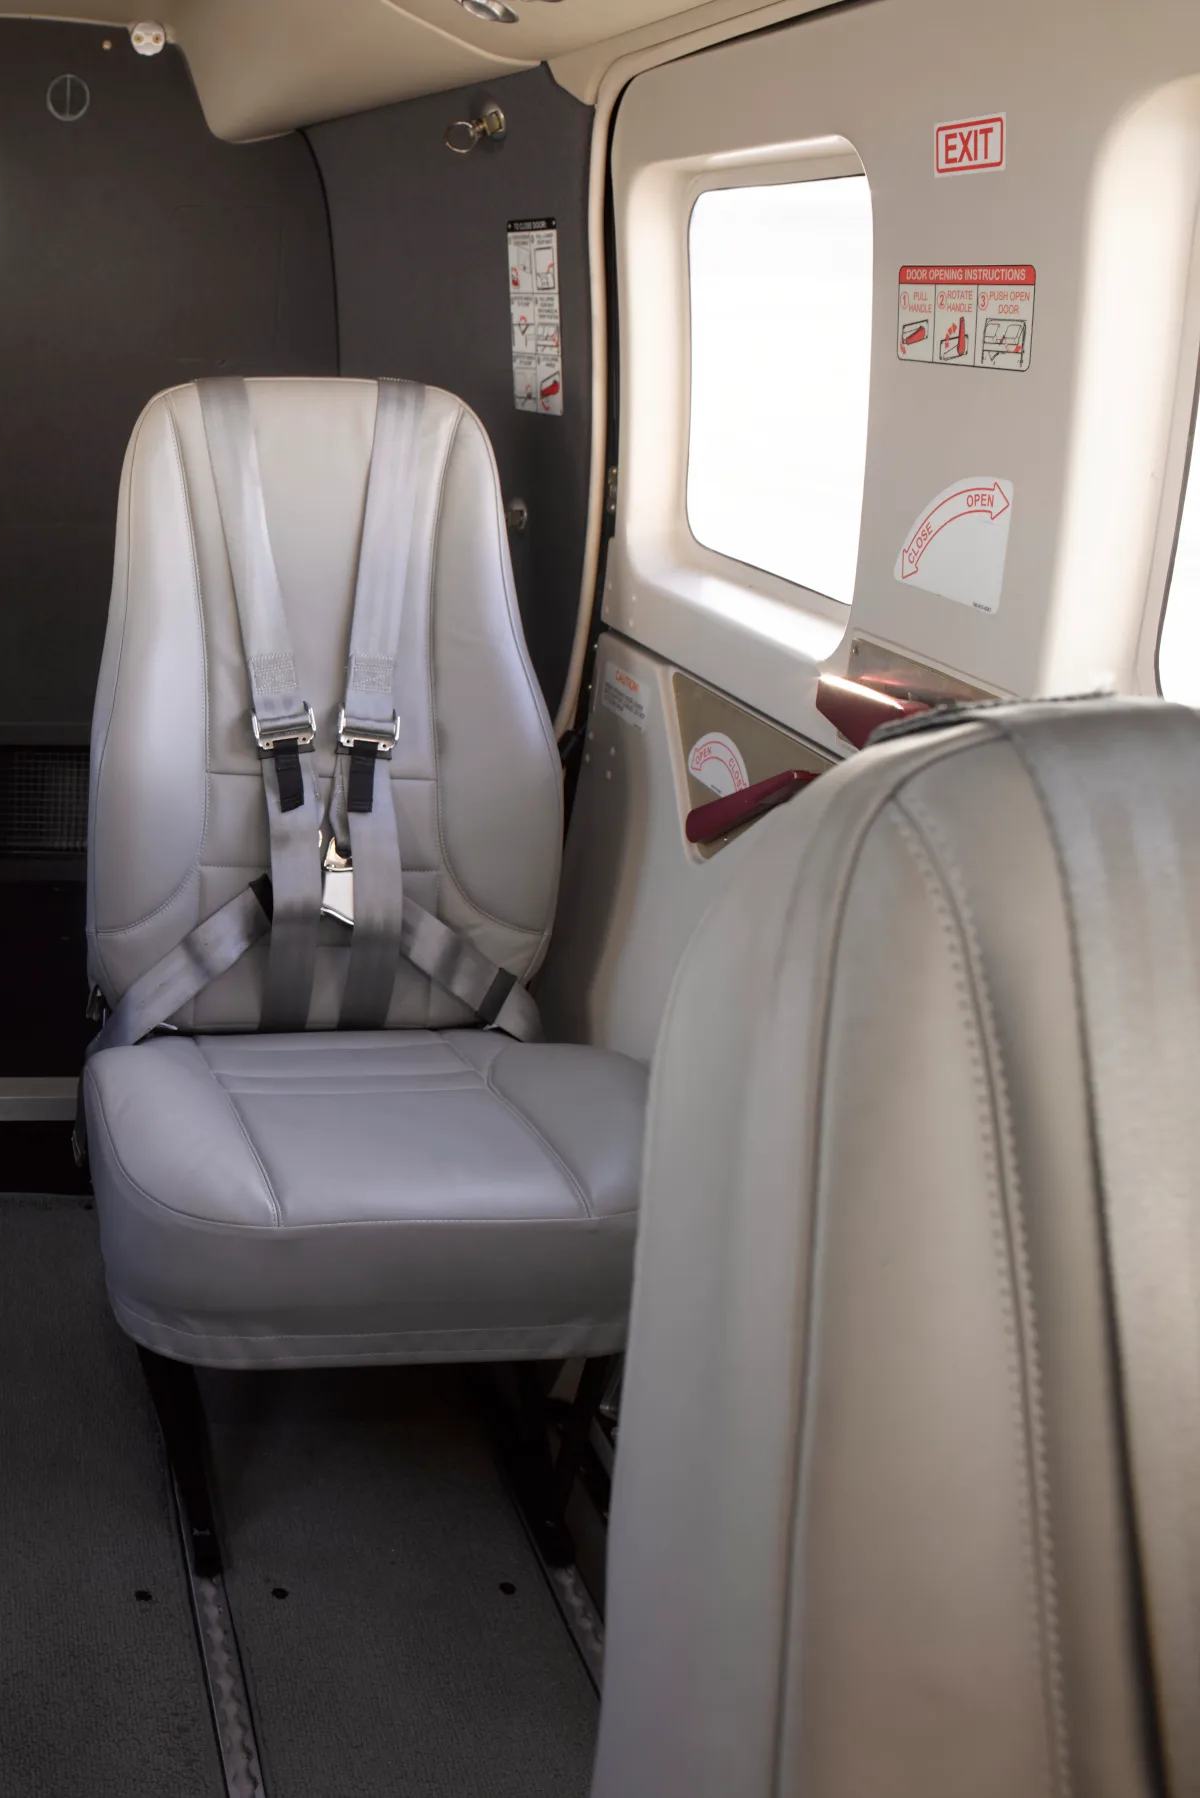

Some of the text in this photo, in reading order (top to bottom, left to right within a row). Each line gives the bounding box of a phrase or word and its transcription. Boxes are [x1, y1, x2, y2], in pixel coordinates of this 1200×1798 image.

[945, 127, 993, 164] EXIT
[906, 268, 1026, 281] DOOR OPENING INSTRUCTIONS
[913, 291, 928, 301] PULL
[947, 290, 973, 300] ROTATE
[989, 291, 1008, 301] PUSH
[1010, 291, 1031, 301] OPEN
[908, 303, 932, 313] HANDLE
[947, 303, 973, 312] HANDLE
[998, 304, 1020, 314] DOOR
[966, 494, 994, 507] OPEN
[908, 522, 933, 564] CLOSE
[695, 747, 712, 764] OPEN
